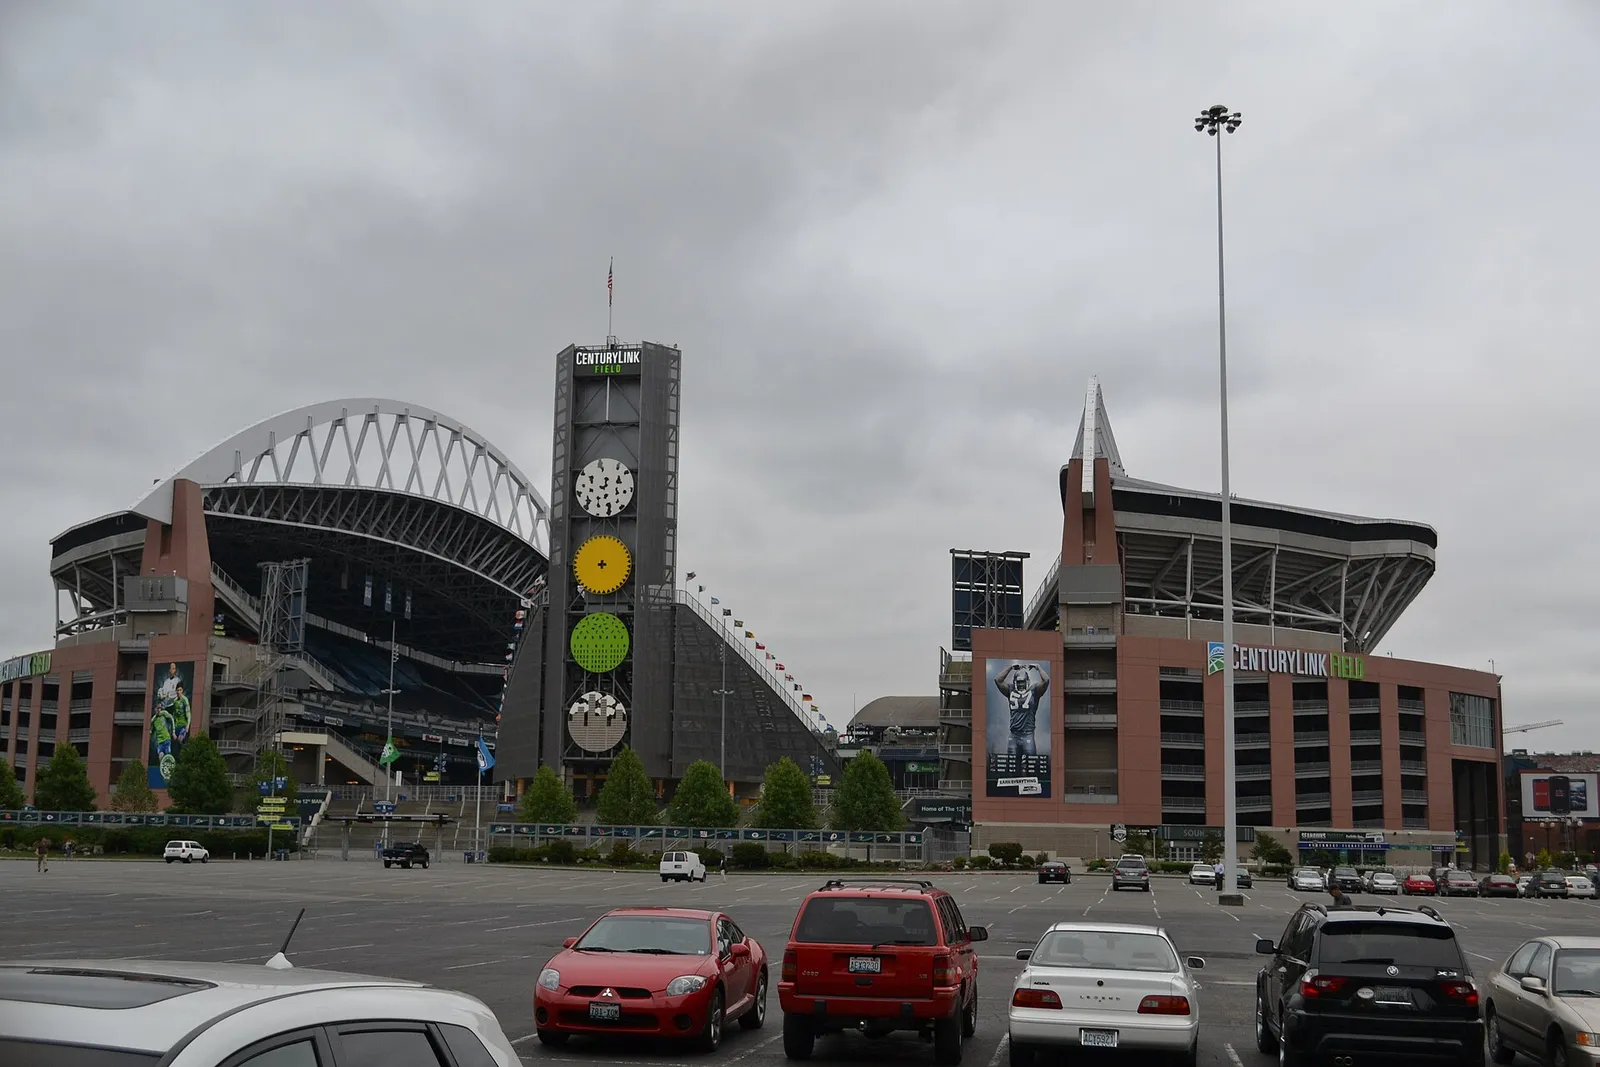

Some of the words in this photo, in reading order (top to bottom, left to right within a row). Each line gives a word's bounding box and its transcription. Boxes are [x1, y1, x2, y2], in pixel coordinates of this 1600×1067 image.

[576, 351, 640, 365] CENTURYLINK
[595, 365, 622, 374] FIELD
[1232, 643, 1328, 677] CENTURYLINK
[1329, 652, 1365, 680] FIELD
[1010, 690, 1032, 710] 57
[1183, 829, 1222, 838] SOUNS
